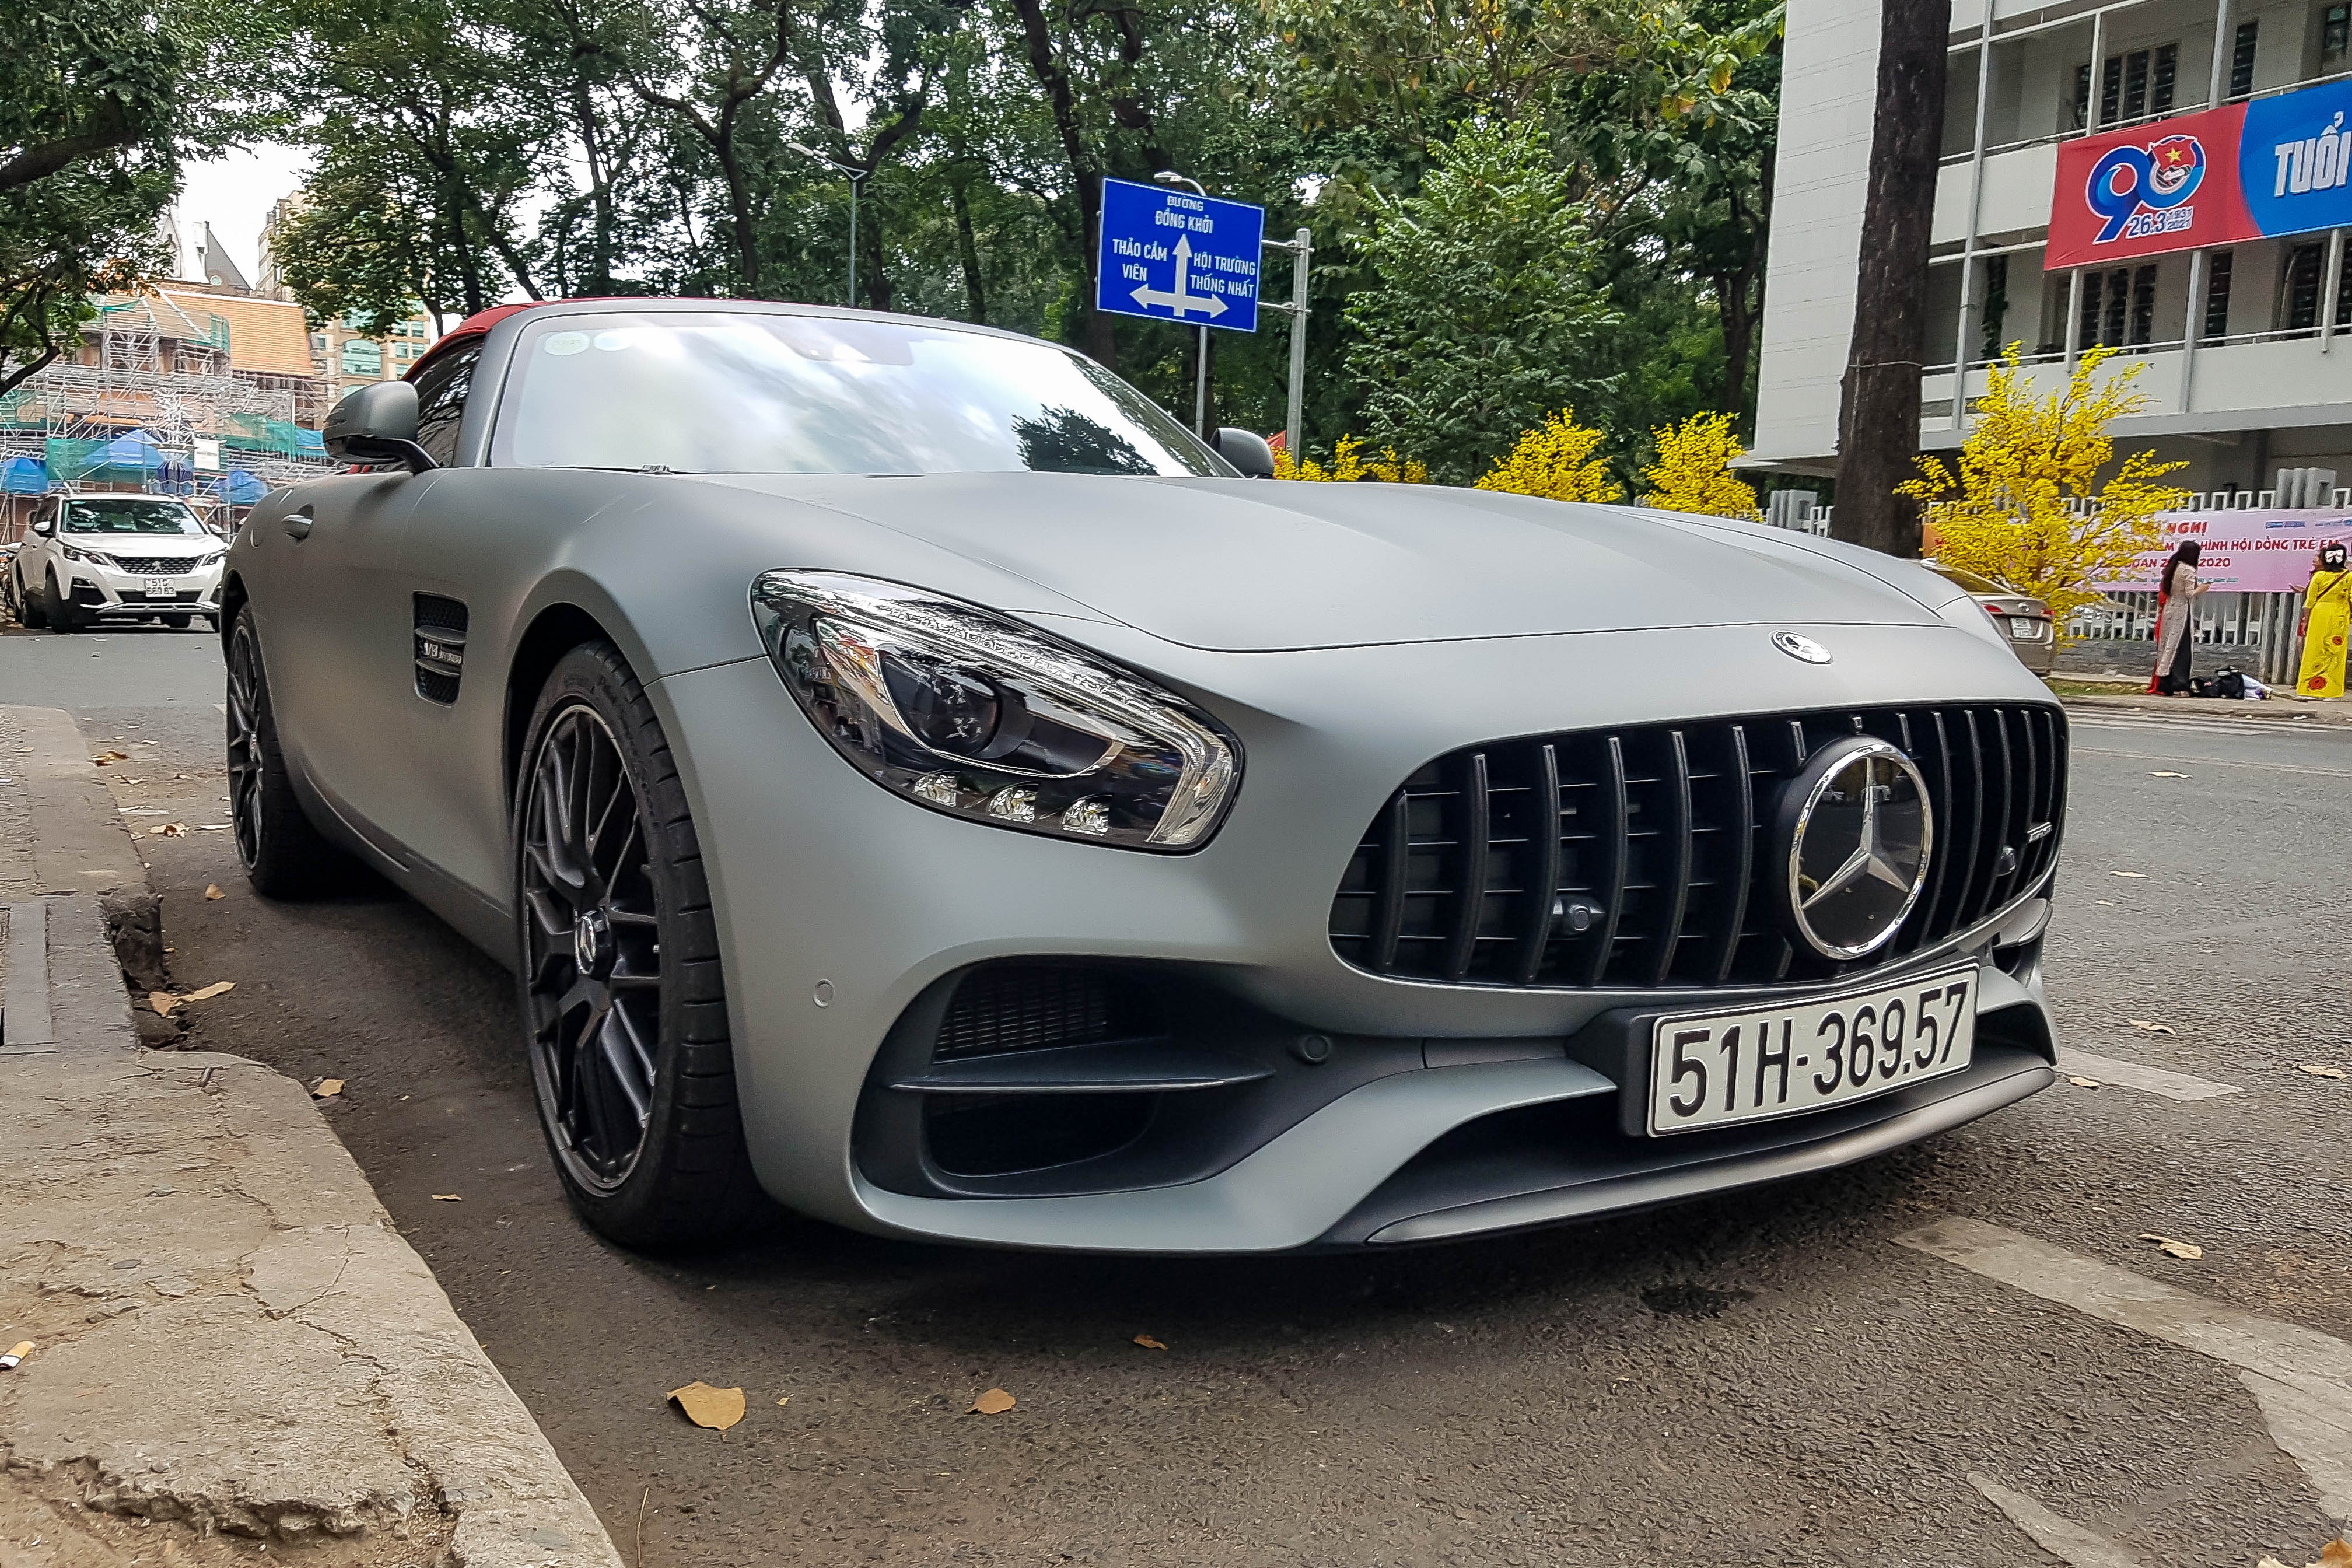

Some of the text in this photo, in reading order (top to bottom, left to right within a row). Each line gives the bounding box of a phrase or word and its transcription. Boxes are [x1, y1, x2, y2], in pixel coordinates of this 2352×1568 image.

[2274, 111, 2351, 197] TUỔI
[1167, 195, 1204, 211] ĐƯỜNG
[1188, 214, 1213, 233] KHỞI
[1112, 237, 1142, 257] THẢO
[1122, 263, 1147, 281] VIÊN
[1194, 251, 1256, 276] HỘI TRƯỜNG
[1190, 272, 1255, 298] THỐNG NHẤT
[1668, 980, 1970, 1118] 51H-369.57
